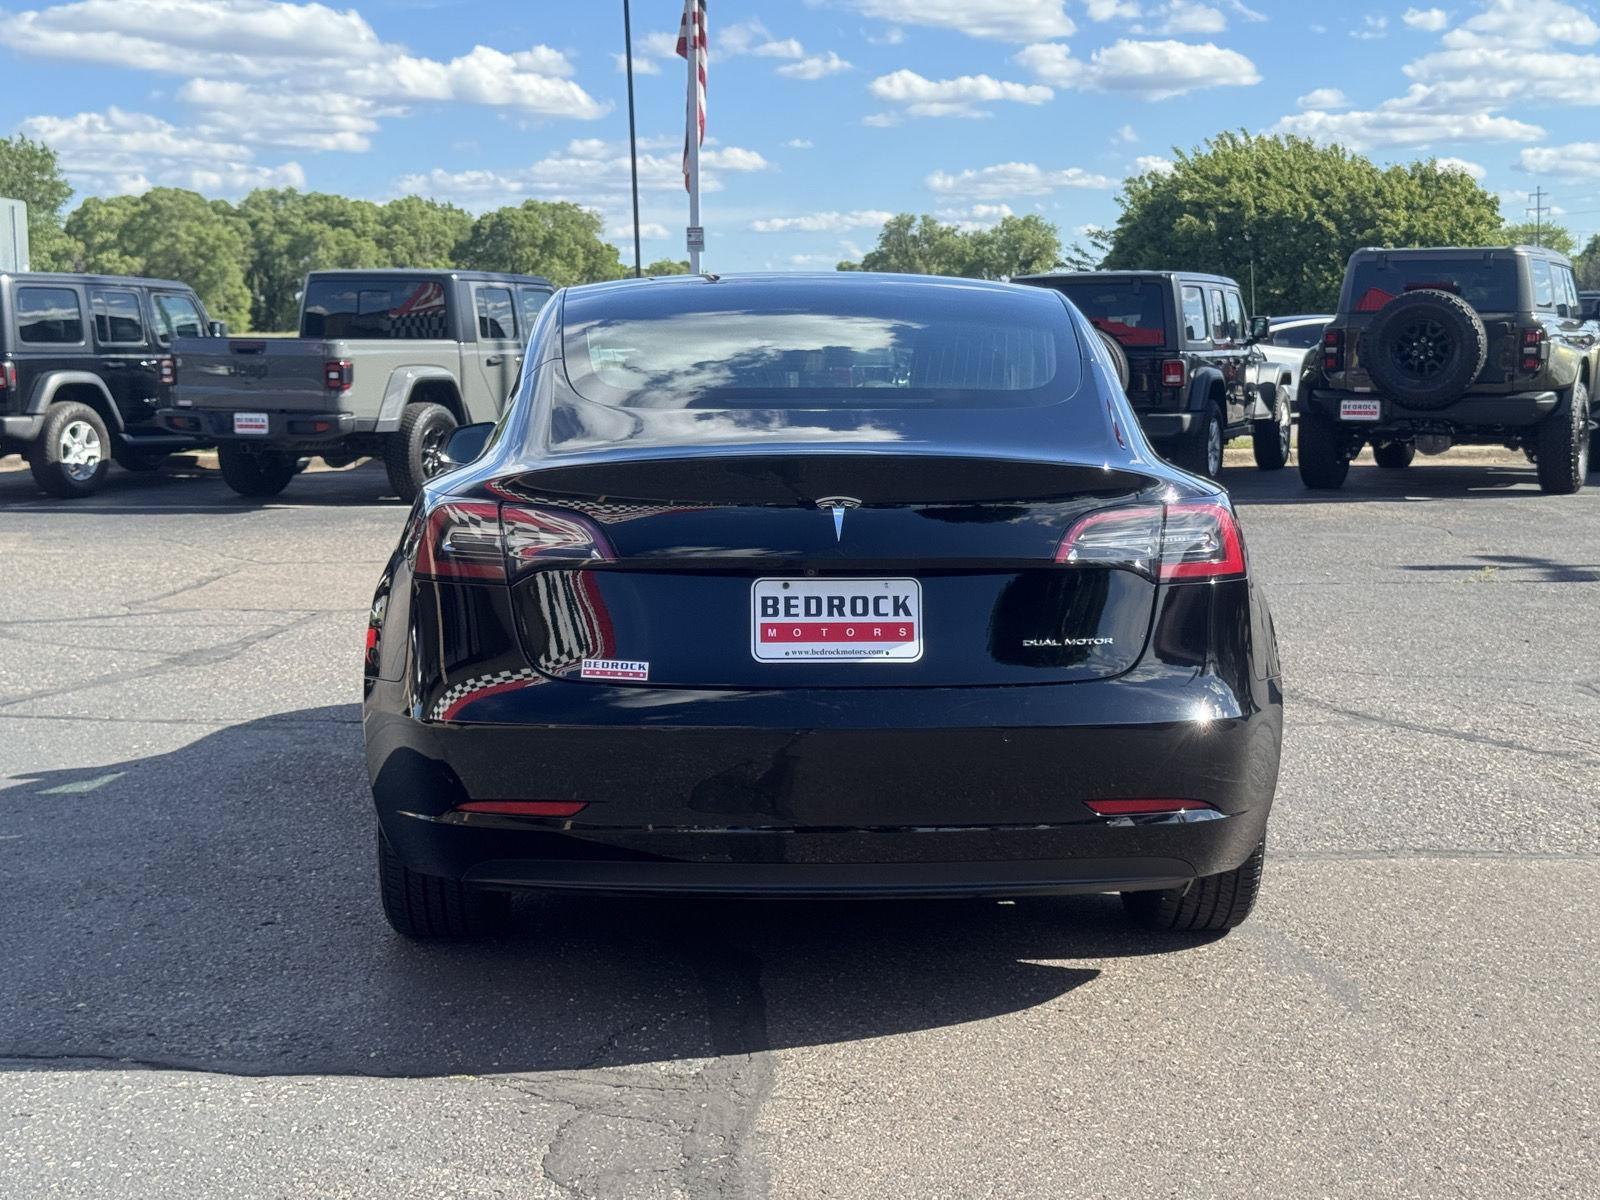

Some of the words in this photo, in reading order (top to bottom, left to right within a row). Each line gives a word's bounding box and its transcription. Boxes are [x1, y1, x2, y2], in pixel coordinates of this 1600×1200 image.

[760, 595, 913, 618] BEDROCK
[767, 628, 908, 638] MOTORS
[1022, 638, 1062, 646] DUAL
[1064, 637, 1114, 645] MOTOR
[791, 648, 884, 656] www.bedrockmotors.com
[583, 660, 647, 671] BEDROCK
